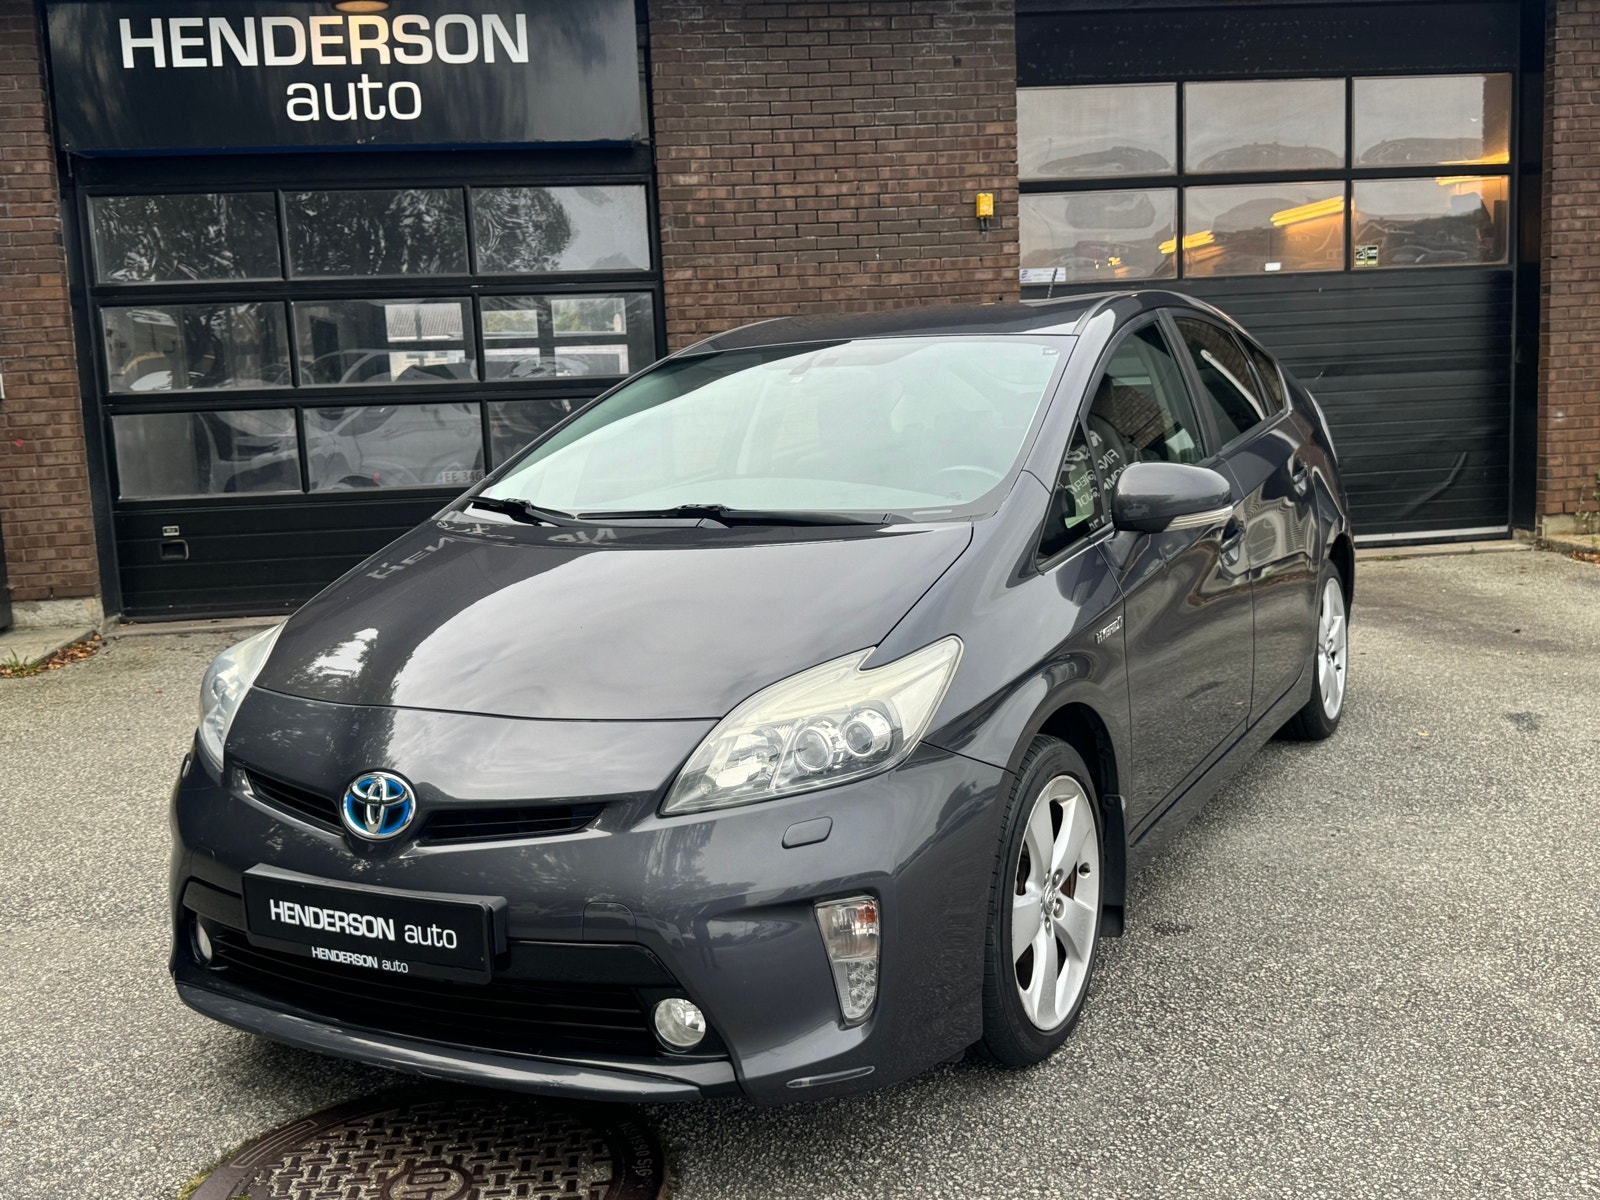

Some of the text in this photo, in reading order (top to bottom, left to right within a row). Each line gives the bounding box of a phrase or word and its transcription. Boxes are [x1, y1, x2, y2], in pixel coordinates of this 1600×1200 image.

[119, 13, 530, 68] HENDERSON
[286, 74, 422, 121] auto
[269, 898, 458, 950] HENDERSON auto
[311, 945, 409, 974] HENDERSON auto
